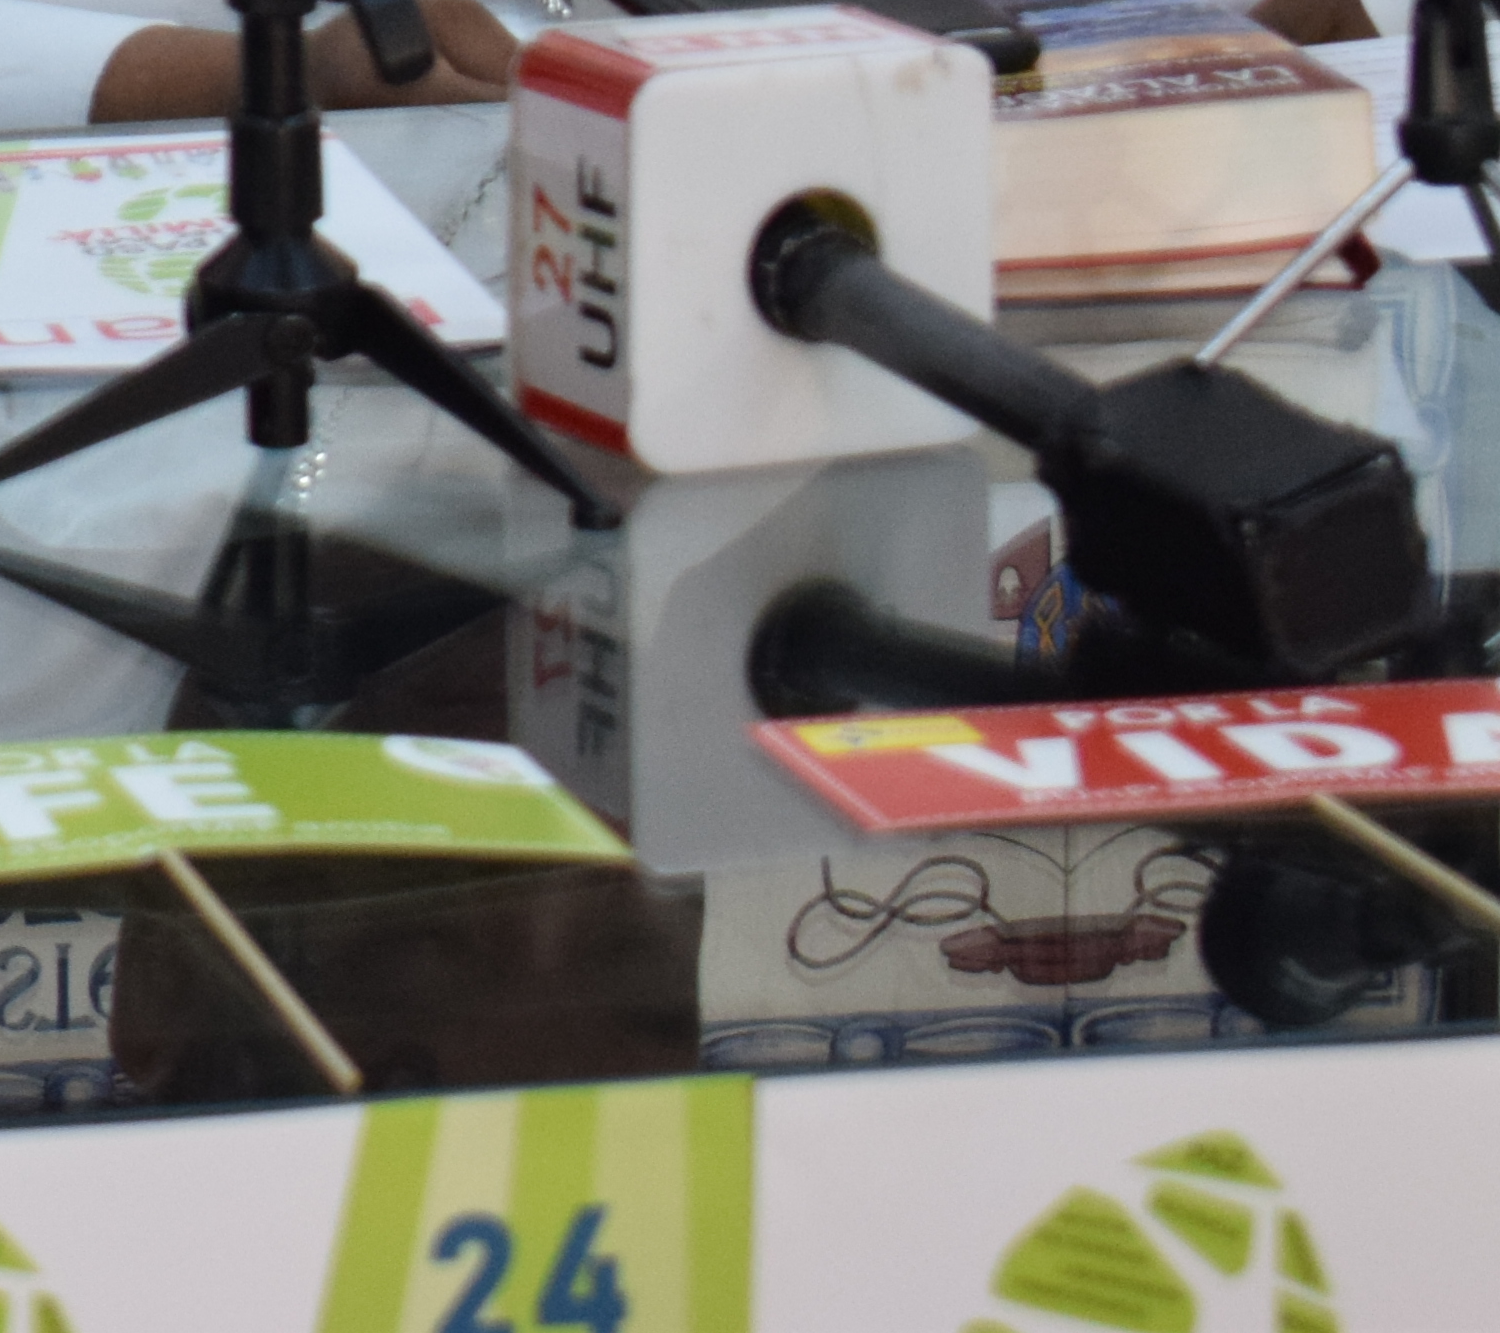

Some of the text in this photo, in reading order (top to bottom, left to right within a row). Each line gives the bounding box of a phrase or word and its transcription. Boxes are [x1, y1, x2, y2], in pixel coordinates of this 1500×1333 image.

[532, 183, 576, 306] 27
[578, 155, 619, 373] UHF
[122, 738, 239, 765] LA
[1051, 693, 1360, 732] POR LA
[431, 1202, 633, 1333] 24
